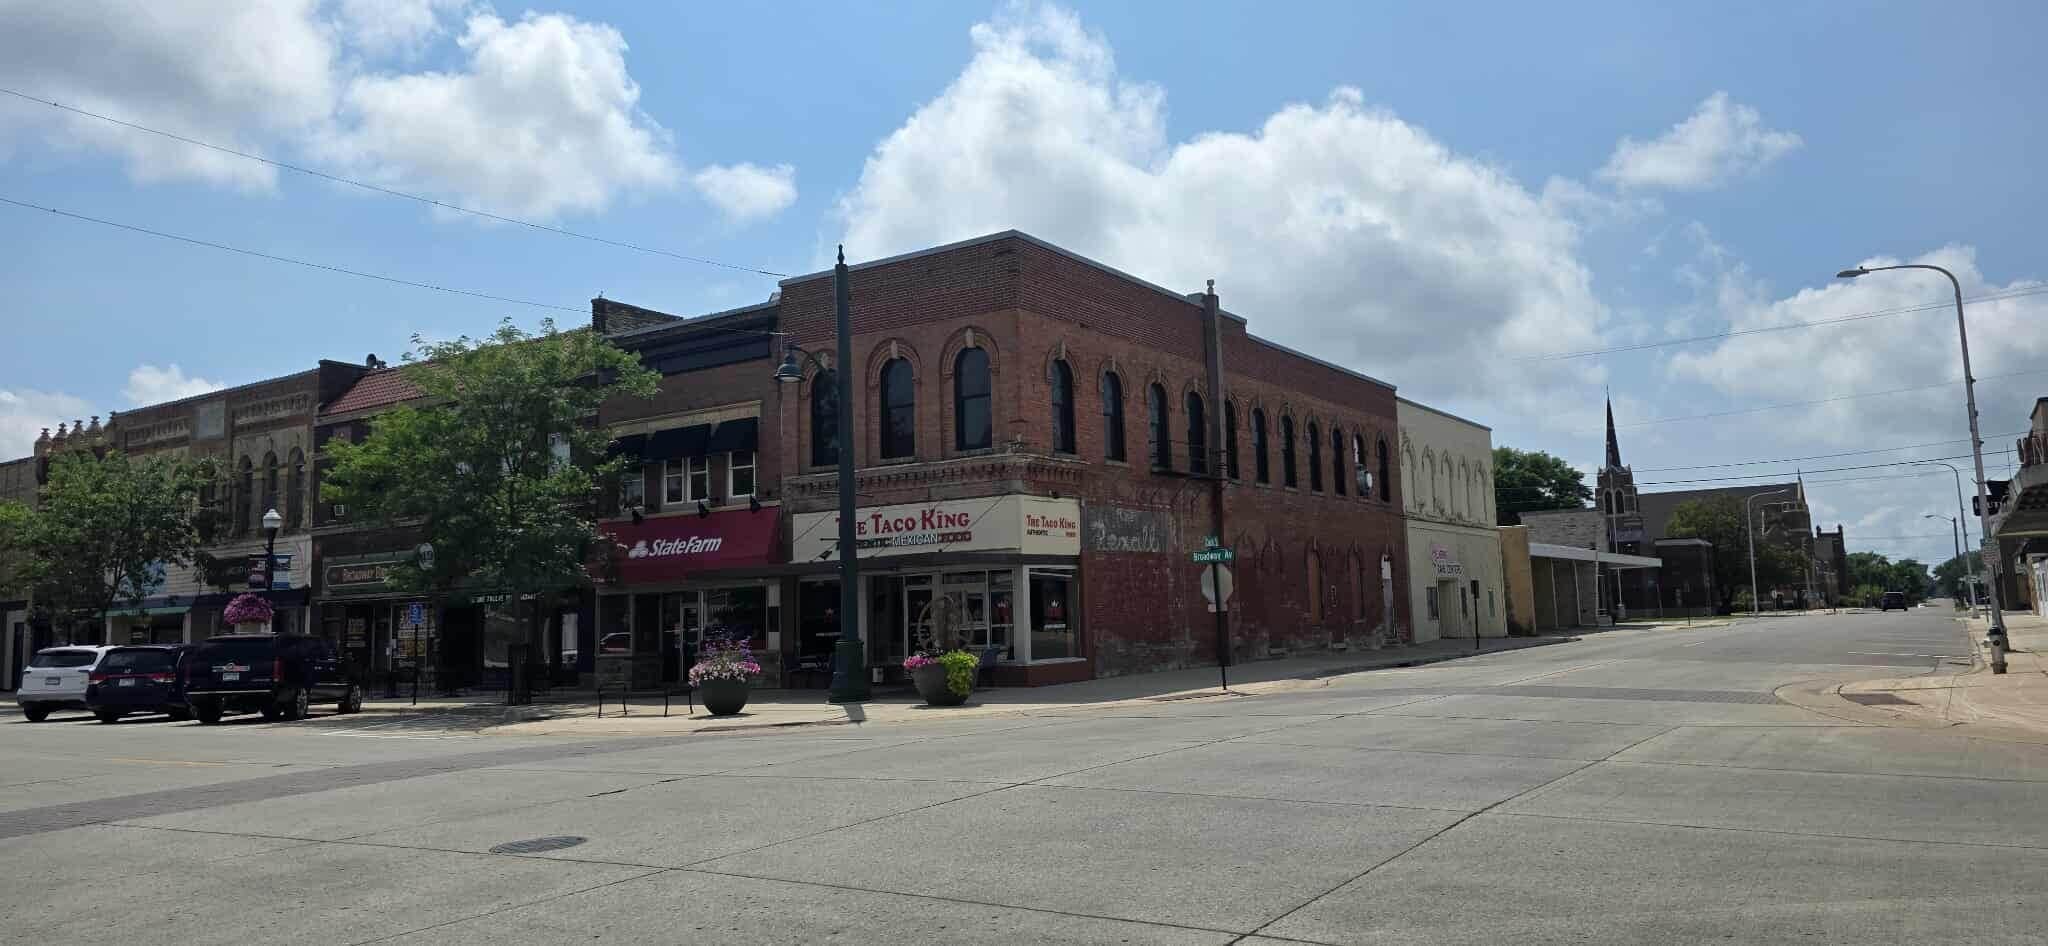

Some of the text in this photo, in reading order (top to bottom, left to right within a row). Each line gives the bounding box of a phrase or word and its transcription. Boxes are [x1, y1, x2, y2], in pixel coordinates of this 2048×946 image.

[871, 513, 916, 535] TACO
[893, 532, 938, 547] MEXICAN
[1091, 519, 1160, 552] Rexall
[1193, 552, 1221, 562] Broadway
